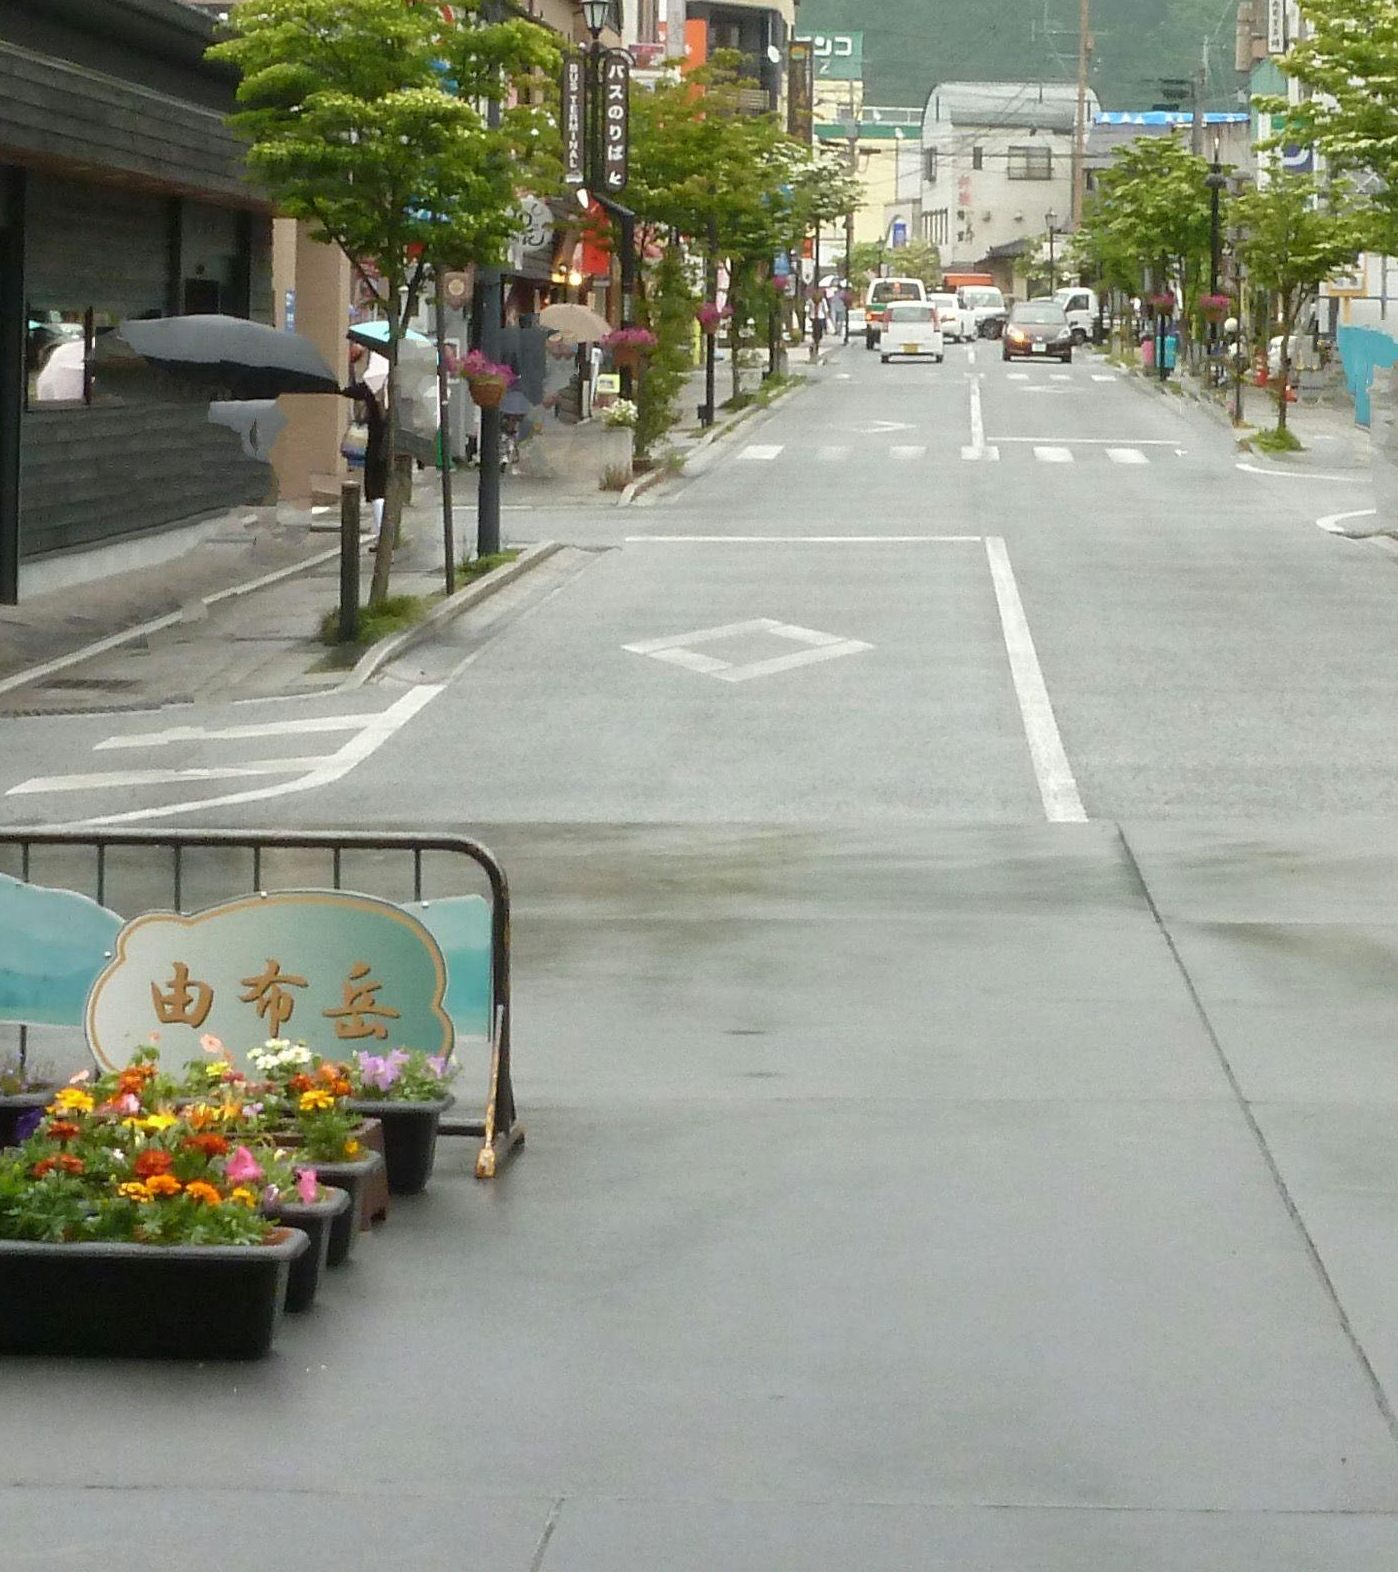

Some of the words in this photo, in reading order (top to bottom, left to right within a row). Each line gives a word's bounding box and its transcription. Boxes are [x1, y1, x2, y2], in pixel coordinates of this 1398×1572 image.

[569, 63, 579, 91] BUS
[795, 36, 852, 56] ンコ
[568, 95, 579, 168] TERMINAL
[608, 65, 624, 161] バスのりば
[151, 958, 401, 1039] 由布岳
